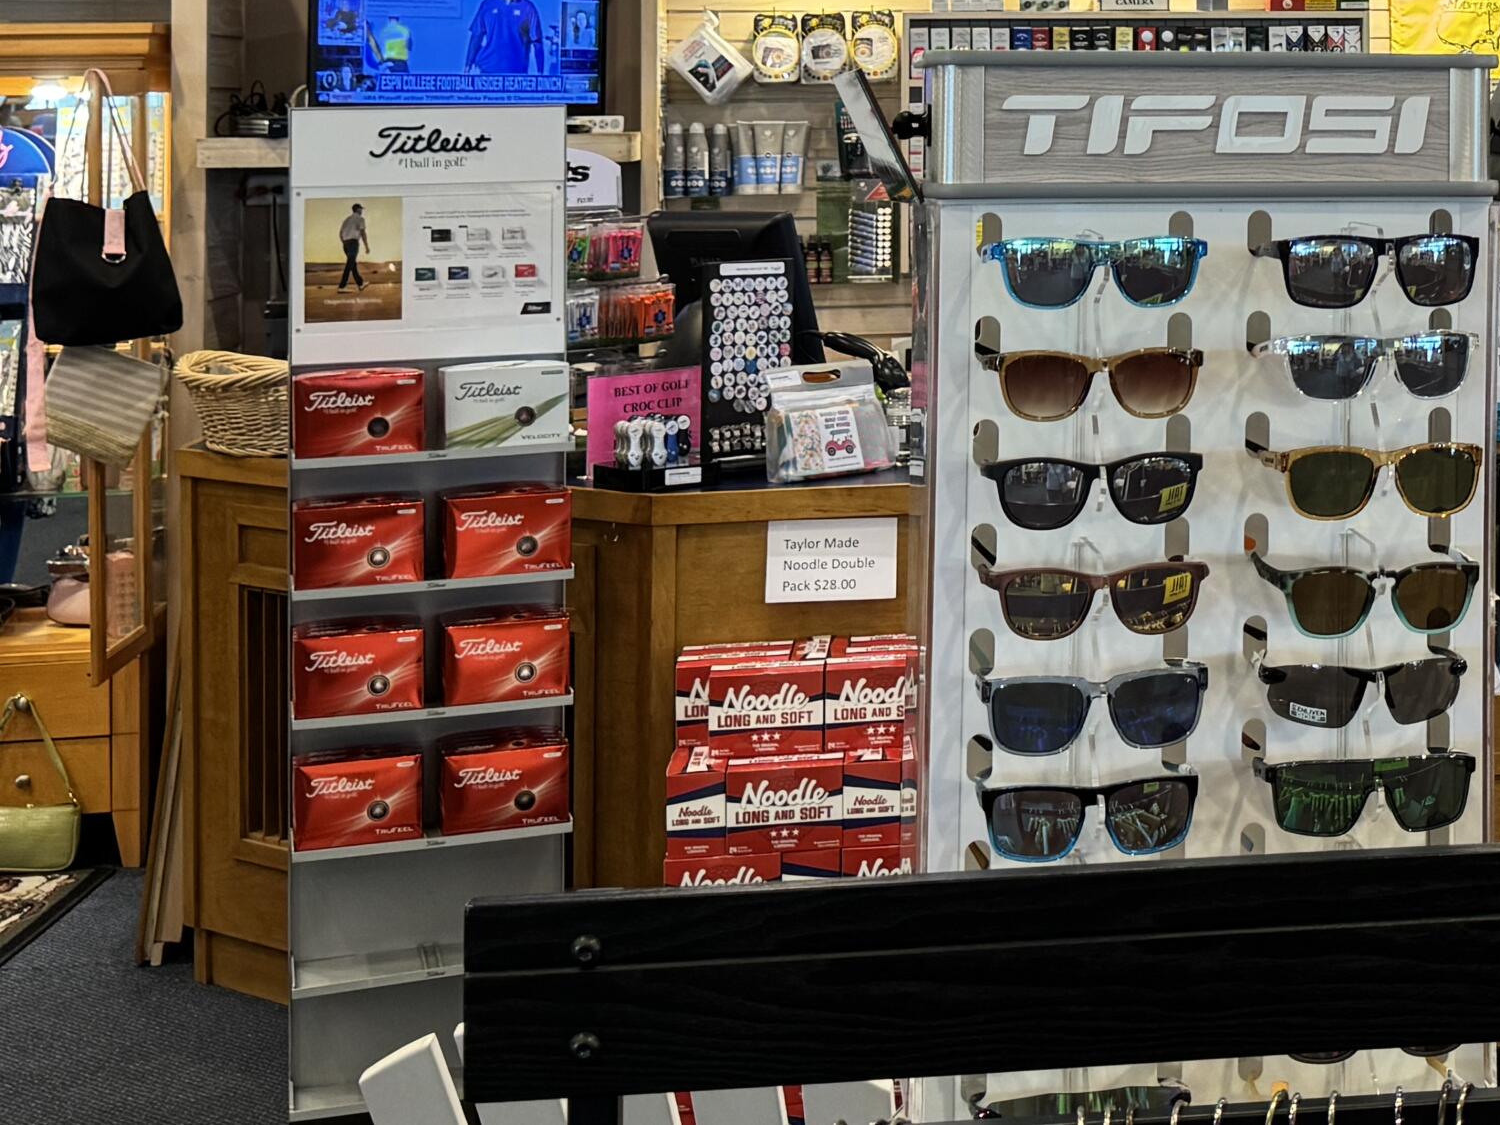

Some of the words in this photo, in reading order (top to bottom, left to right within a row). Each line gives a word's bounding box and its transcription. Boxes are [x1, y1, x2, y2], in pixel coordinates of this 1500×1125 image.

[403, 76, 435, 91] COLLEGE
[1001, 95, 1432, 156] TIFOSI
[369, 124, 492, 158] Titleist
[432, 158, 442, 167] in
[455, 381, 522, 401] Titleist
[614, 385, 641, 397] BEST
[644, 383, 658, 393] OF
[661, 379, 689, 392] GOLF
[304, 390, 375, 412] Titleist
[623, 400, 655, 413] CROC
[657, 397, 682, 409] CLIP
[521, 432, 561, 440] VELOCITY
[456, 510, 524, 532] Titleist
[304, 521, 375, 543] Titleist
[784, 537, 821, 551] Taylor
[824, 537, 860, 548] Made
[783, 558, 827, 571] Noodle
[831, 557, 876, 569] Double
[782, 579, 811, 593] Pack
[814, 578, 857, 591] $28.00
[455, 637, 522, 659] Titleist
[305, 650, 375, 672] Titleist
[723, 683, 810, 713] Noodle
[717, 715, 750, 729] LONG
[756, 713, 776, 724] AND
[781, 710, 813, 724] SOFT
[834, 707, 867, 721] LONG
[871, 706, 891, 716] AND
[454, 766, 521, 788] Titleist
[305, 776, 375, 799] Titleist
[740, 777, 830, 808] Noodle
[854, 795, 887, 806] Noodle
[678, 806, 713, 817] Noodle
[703, 816, 720, 824] SOFT
[735, 810, 770, 824] LONG
[774, 809, 795, 820] AND
[800, 806, 833, 820] SOFT
